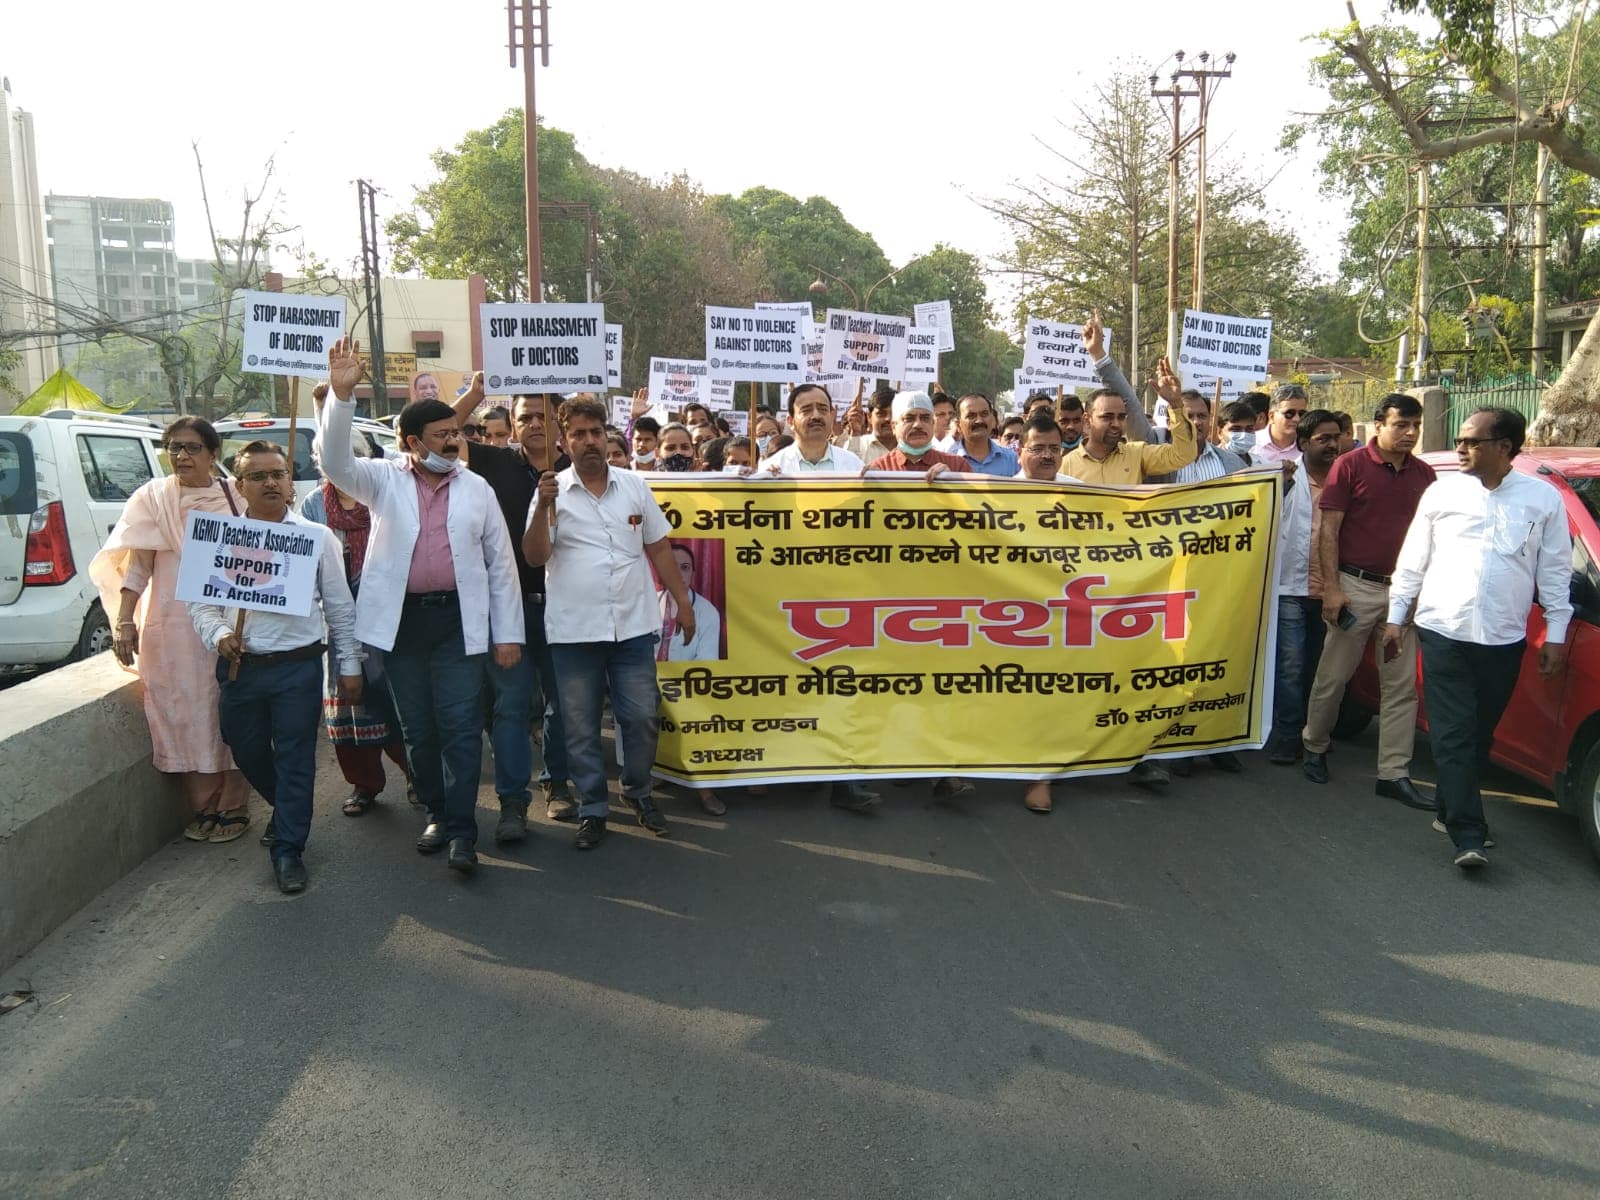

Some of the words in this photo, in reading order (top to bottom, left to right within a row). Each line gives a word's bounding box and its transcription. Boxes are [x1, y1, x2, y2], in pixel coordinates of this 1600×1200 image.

[253, 304, 277, 322] STOP
[280, 306, 341, 328] HARASSMENT
[710, 316, 726, 330] SAY
[728, 318, 741, 332] NO
[743, 318, 754, 332] TO
[756, 319, 796, 334] VIOLENCE
[830, 314, 846, 331] KGMU
[872, 318, 906, 338] Association
[490, 318, 518, 338] STOP
[521, 317, 598, 337] HARASSMENT
[1052, 328, 1082, 340] अर्चन
[1184, 316, 1199, 330] SAY
[1201, 320, 1213, 333] NO
[1215, 322, 1225, 334] TO
[1227, 323, 1268, 339] VIOLENCE
[269, 332, 281, 349] OF
[283, 333, 324, 353] DOCTORS
[714, 336, 752, 352] AGAINST
[753, 338, 792, 353] DOCTORS
[843, 340, 885, 353] SUPPORT
[909, 334, 935, 345] OLENCE
[1186, 335, 1221, 352] AGAINST
[1222, 340, 1262, 356] DOCTORS
[512, 346, 526, 367] OF
[528, 346, 579, 366] DOCTORS
[838, 360, 850, 370] Dr.
[852, 362, 889, 374] Archana
[856, 352, 869, 362] for
[1073, 358, 1087, 368] दो
[664, 379, 696, 388] SUPPORT
[692, 501, 793, 530] अर्चना
[802, 500, 875, 530] शर्मा
[1123, 498, 1255, 529] राजस्थान
[192, 518, 220, 543] KGMU
[264, 528, 315, 557] Association
[736, 539, 764, 566] के
[770, 544, 892, 566] आत्महत्या
[899, 538, 962, 565] करने
[968, 544, 1002, 564] पर
[1006, 544, 1082, 574] मजबूर
[1085, 538, 1143, 564] करने
[1144, 536, 1174, 559] के
[1179, 530, 1230, 558] विरोध
[1235, 527, 1256, 553] में
[214, 555, 282, 576] SUPPORT
[235, 573, 256, 588] for
[202, 584, 222, 599] Dr.
[226, 586, 287, 606] Archana
[778, 574, 1198, 662] प्रदर्शन
[796, 665, 926, 696] मेडिकल
[1131, 660, 1228, 692] लखनऊ
[680, 714, 745, 734] मनीष
[752, 718, 819, 732] टण्डन
[689, 748, 765, 764] अध्यक्ष
